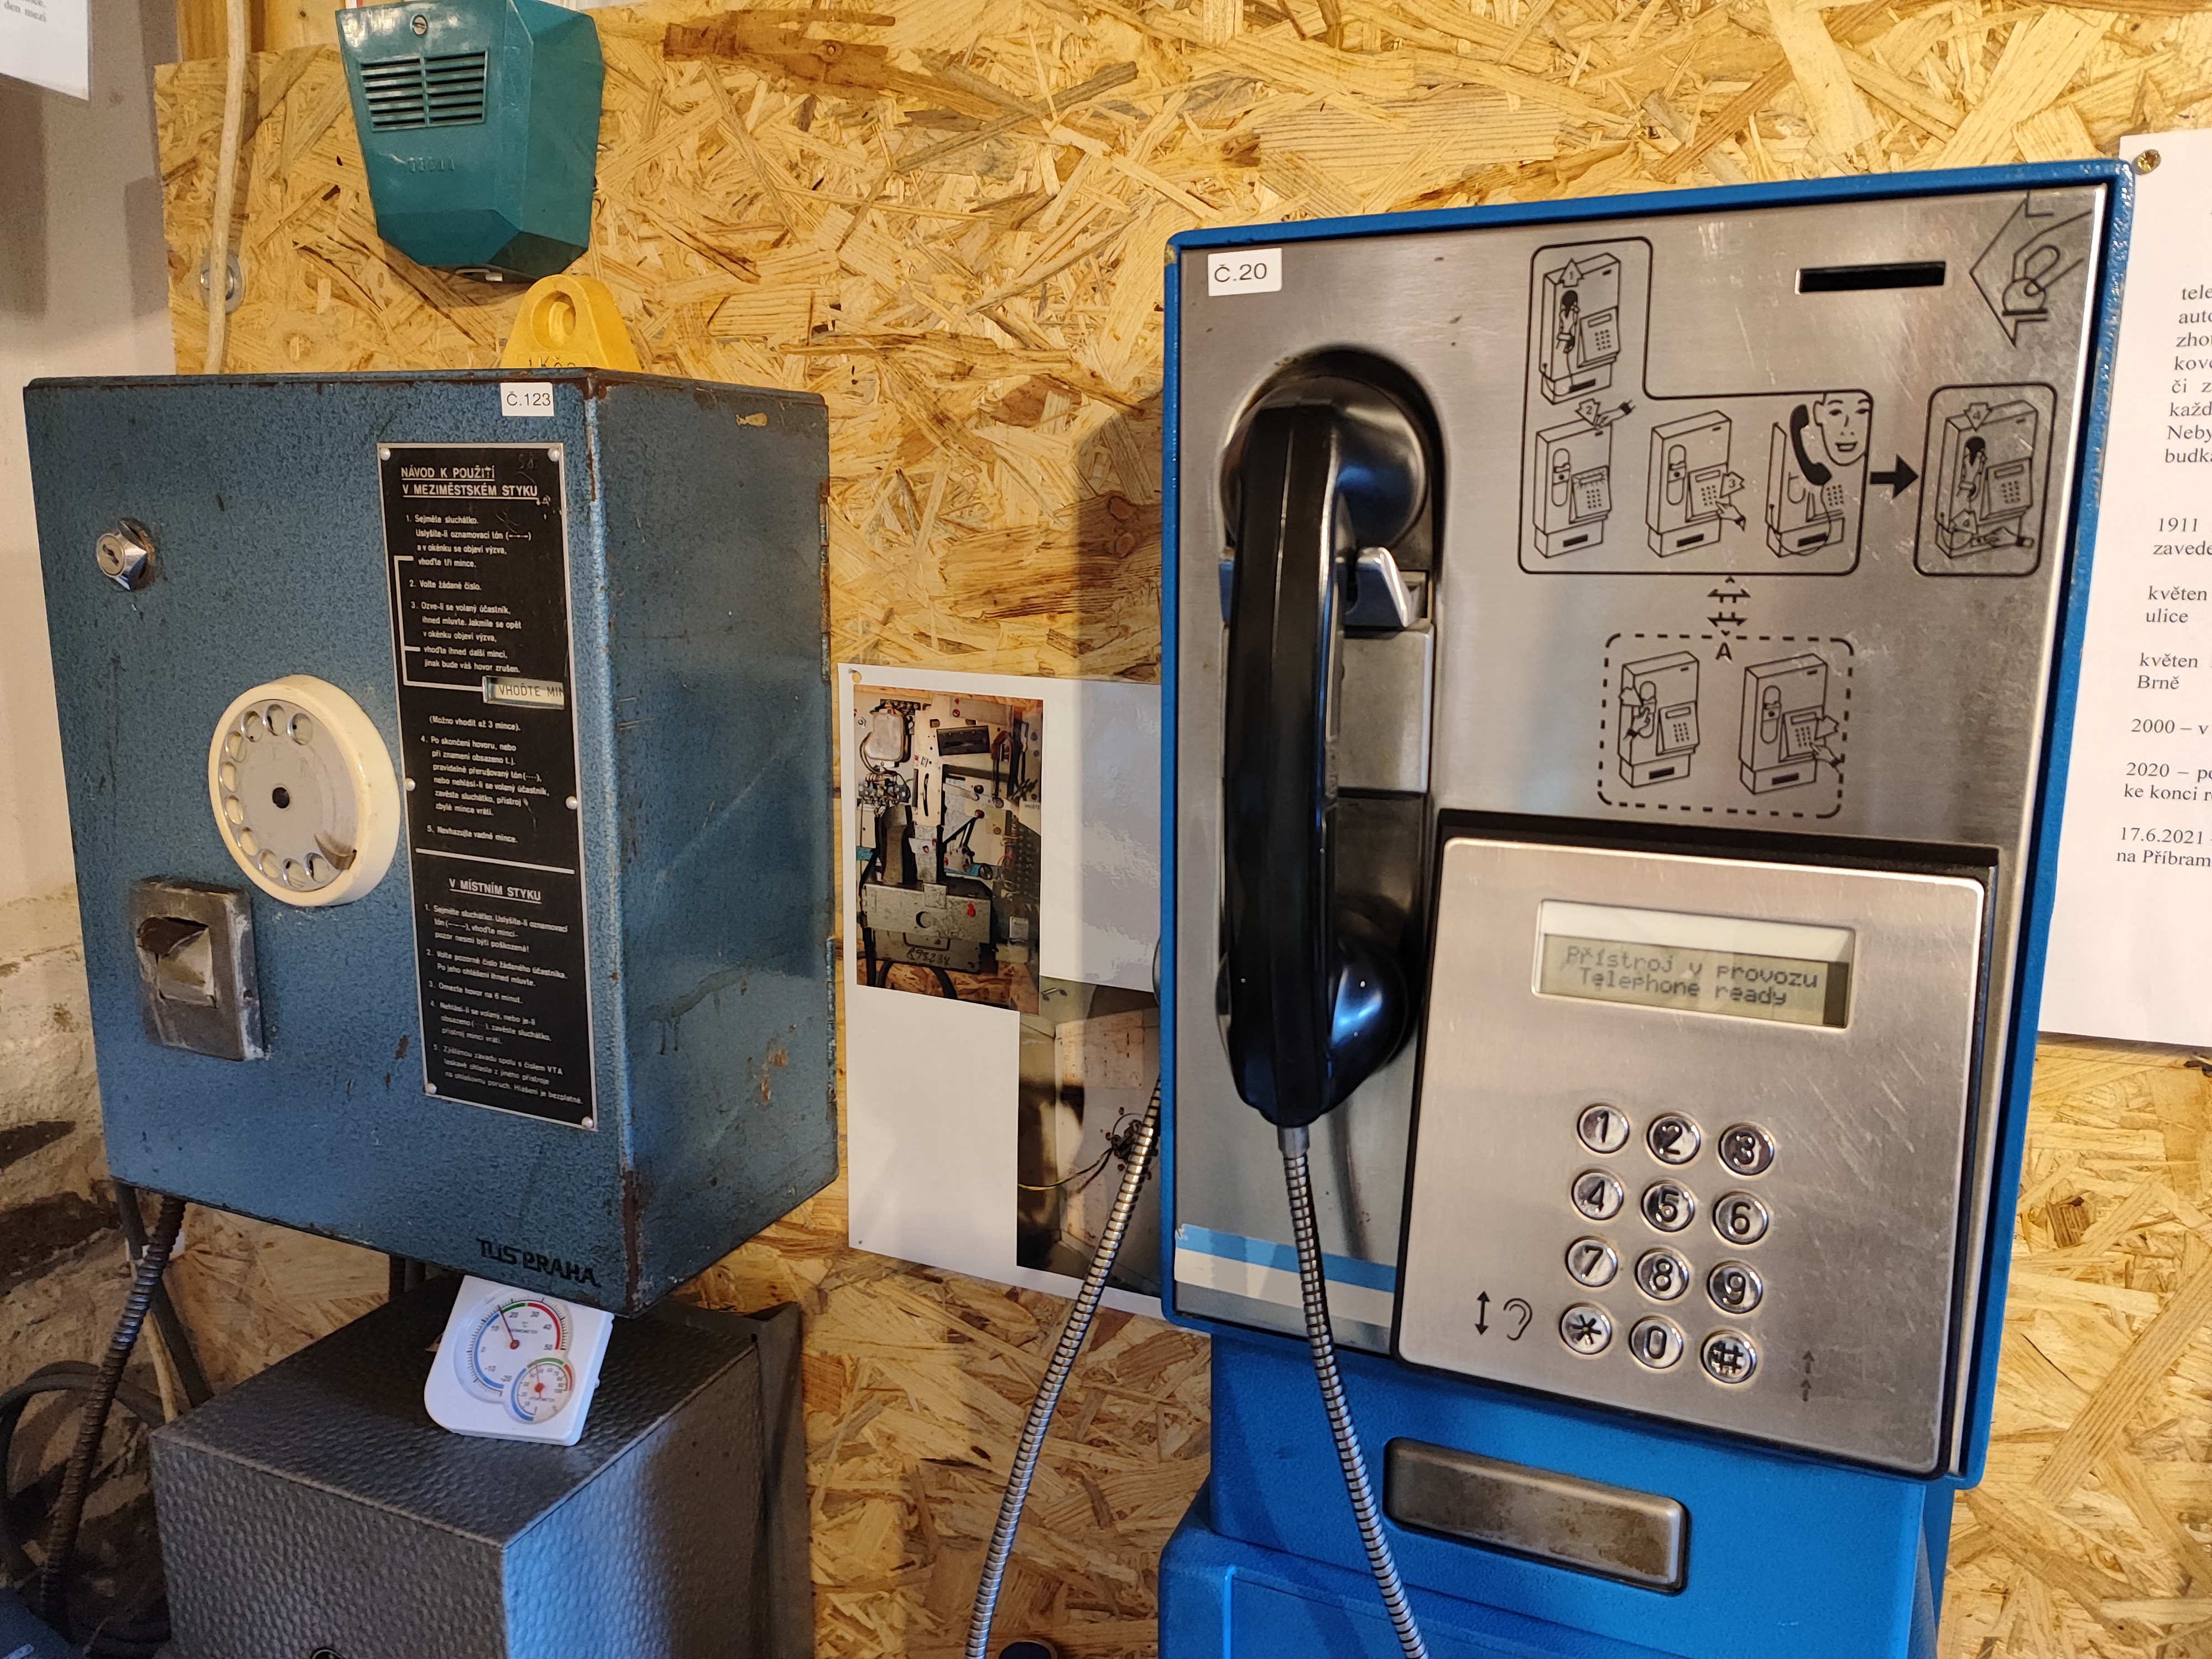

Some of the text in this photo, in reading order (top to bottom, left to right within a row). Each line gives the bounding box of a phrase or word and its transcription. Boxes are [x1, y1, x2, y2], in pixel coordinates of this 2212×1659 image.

[1214, 263, 1267, 283] Č.20
[1569, 270, 1574, 280] 1
[2176, 332, 2212, 347] zho
[2174, 356, 2212, 371] kov
[2172, 378, 2212, 394] či z
[507, 391, 551, 406] Č.123
[1585, 405, 1593, 415] 2
[2165, 448, 2212, 463] budk
[401, 465, 495, 479] NÁVOD K POUŽITÍ
[403, 482, 538, 496] V MEZIMĚSTSKÉM STYKU
[1728, 478, 1736, 488] 3
[406, 514, 411, 523] 1.
[2158, 517, 2198, 532] 1911
[2147, 585, 2207, 601] květen
[2146, 608, 2189, 623] ulice
[1716, 642, 1732, 660] A
[2139, 652, 2198, 667] květen
[499, 682, 541, 696] VHOĎTE
[2137, 675, 2179, 690] Brně
[488, 720, 493, 728] 3
[2131, 718, 2209, 735] 2000 v
[2126, 762, 2169, 778] 2020
[2124, 783, 2144, 797] ke
[2150, 784, 2198, 800] konci
[2121, 827, 2203, 845] 17.6.2021
[2116, 852, 2136, 863] na
[449, 878, 542, 901] V MÍSTNÍM STYKU
[1566, 945, 1818, 988] Přístroj v provozu
[1580, 967, 1787, 1006] Telephone ready
[546, 1066, 563, 1075] VTA
[1599, 1110, 1756, 1166] 1 2 3
[1585, 1180, 1752, 1235] 4 5 6
[523, 1251, 601, 1288] PRAHA
[1583, 1245, 1747, 1305] 7 8 9
[1644, 1325, 1667, 1359] 0
